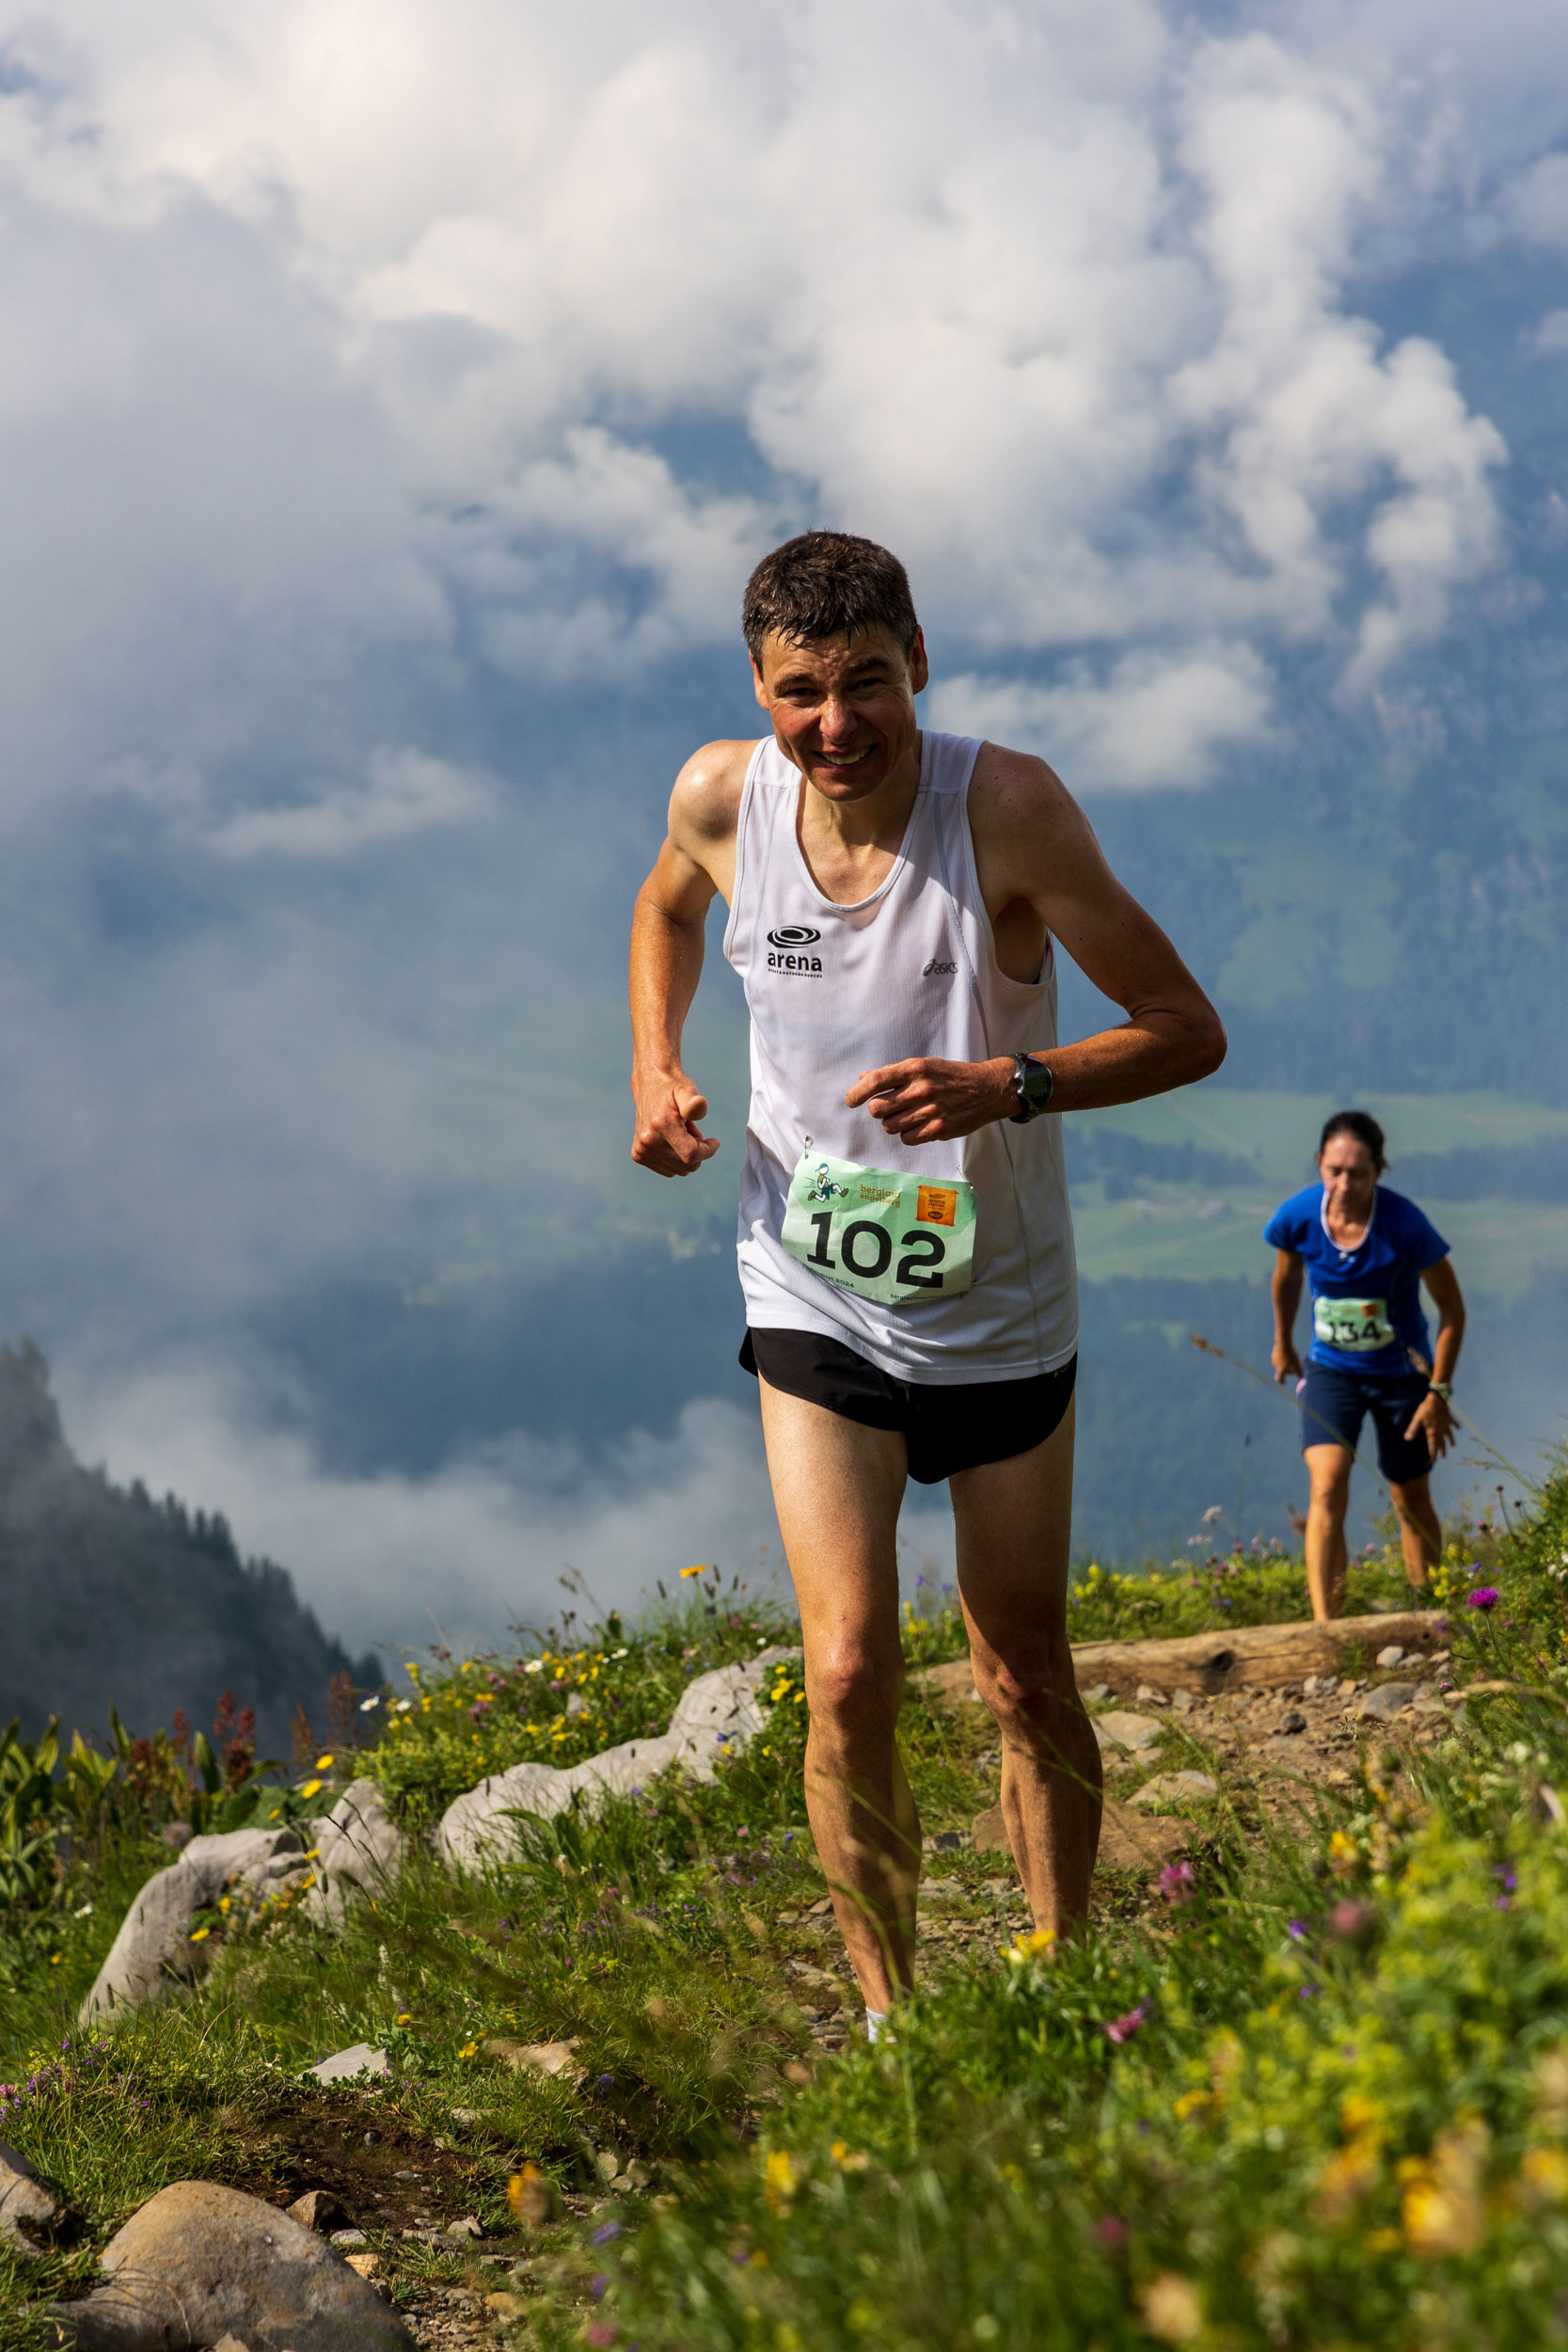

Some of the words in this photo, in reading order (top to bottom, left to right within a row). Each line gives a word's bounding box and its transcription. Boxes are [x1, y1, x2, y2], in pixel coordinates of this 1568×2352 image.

[768, 952, 823, 972] arena
[860, 1184, 901, 1199] berglauf
[860, 1194, 901, 1209] engelberg
[806, 1211, 946, 1289] 102
[835, 1278, 855, 1288] 2024
[1328, 1321, 1382, 1343] 134
